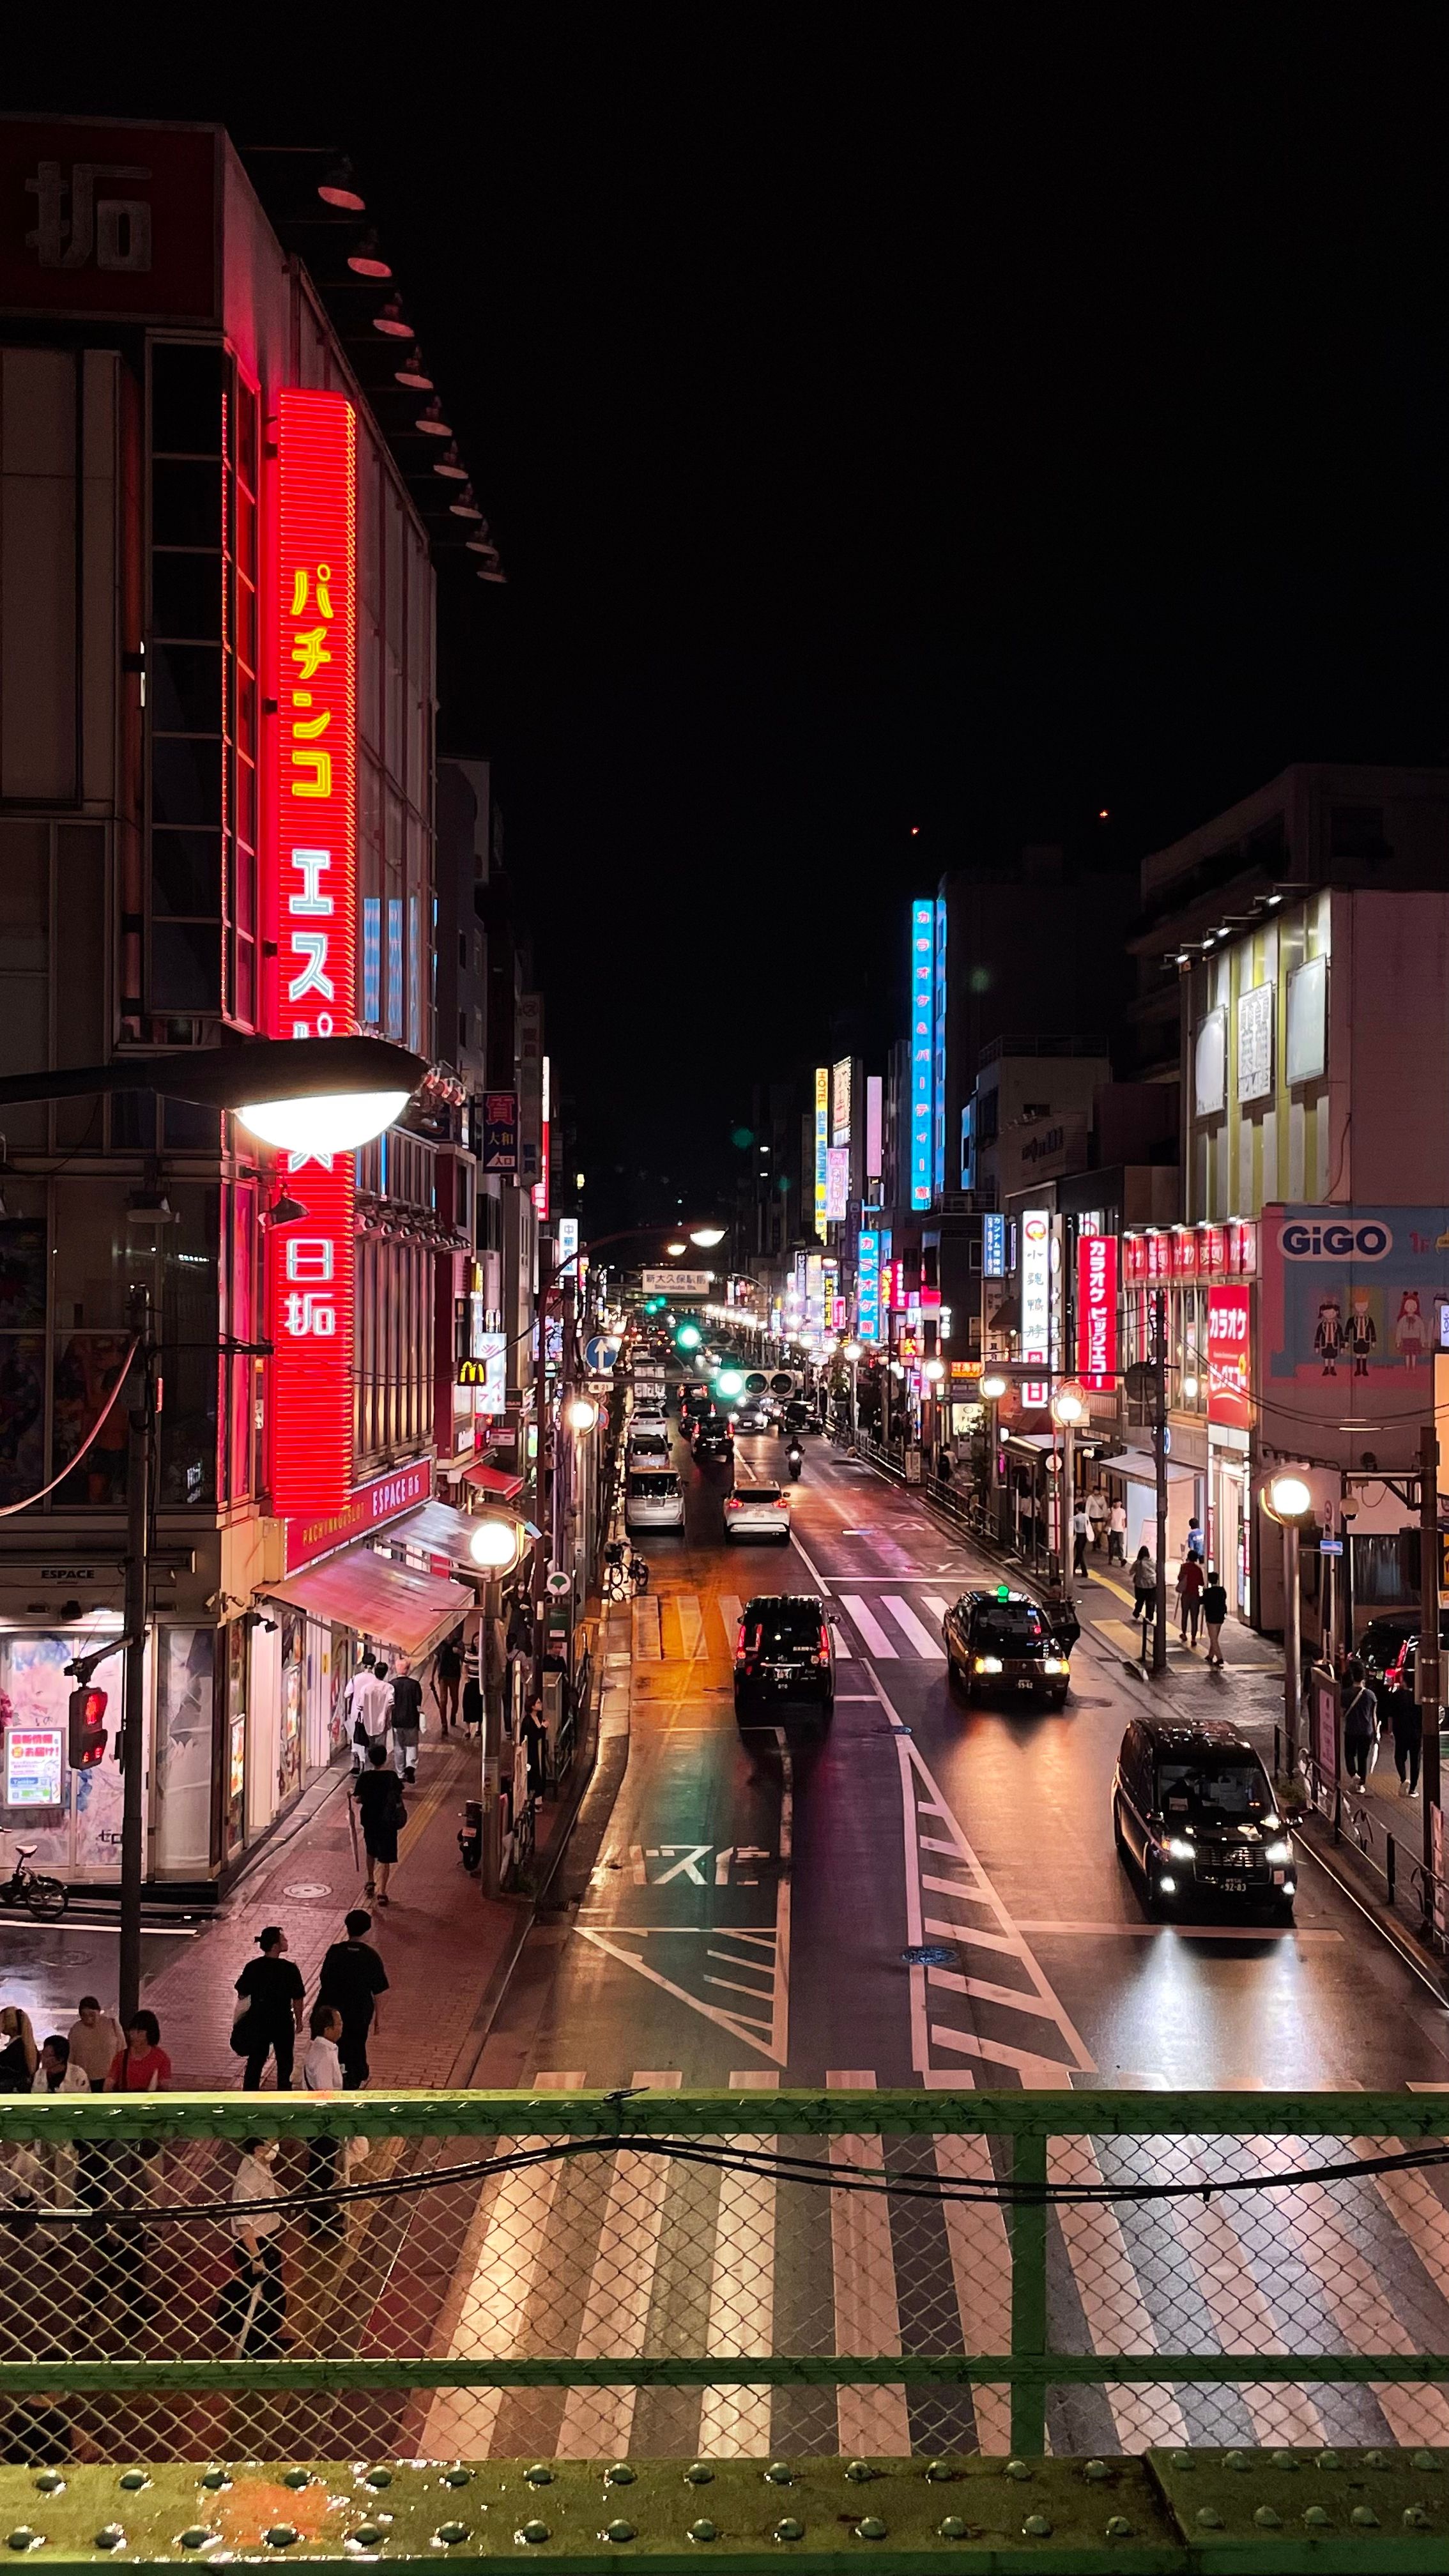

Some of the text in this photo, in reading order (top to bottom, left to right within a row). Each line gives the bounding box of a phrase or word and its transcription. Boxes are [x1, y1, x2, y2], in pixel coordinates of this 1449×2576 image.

[290, 564, 334, 798] パチンコ
[816, 1070, 826, 1103] HOTEL
[486, 1094, 516, 1126] 質
[487, 1131, 514, 1146] 大和
[495, 1157, 512, 1166] 入口
[1283, 1226, 1387, 1255] GiGO
[286, 1238, 335, 1337] 日拓
[646, 1274, 706, 1284] 新大久保駅前
[1089, 1241, 1107, 1388] カラオケ ビッグエコー
[1209, 1307, 1246, 1340] カラオケ
[372, 1478, 406, 1516] ESPACE
[41, 1569, 95, 1579] ESPACE
